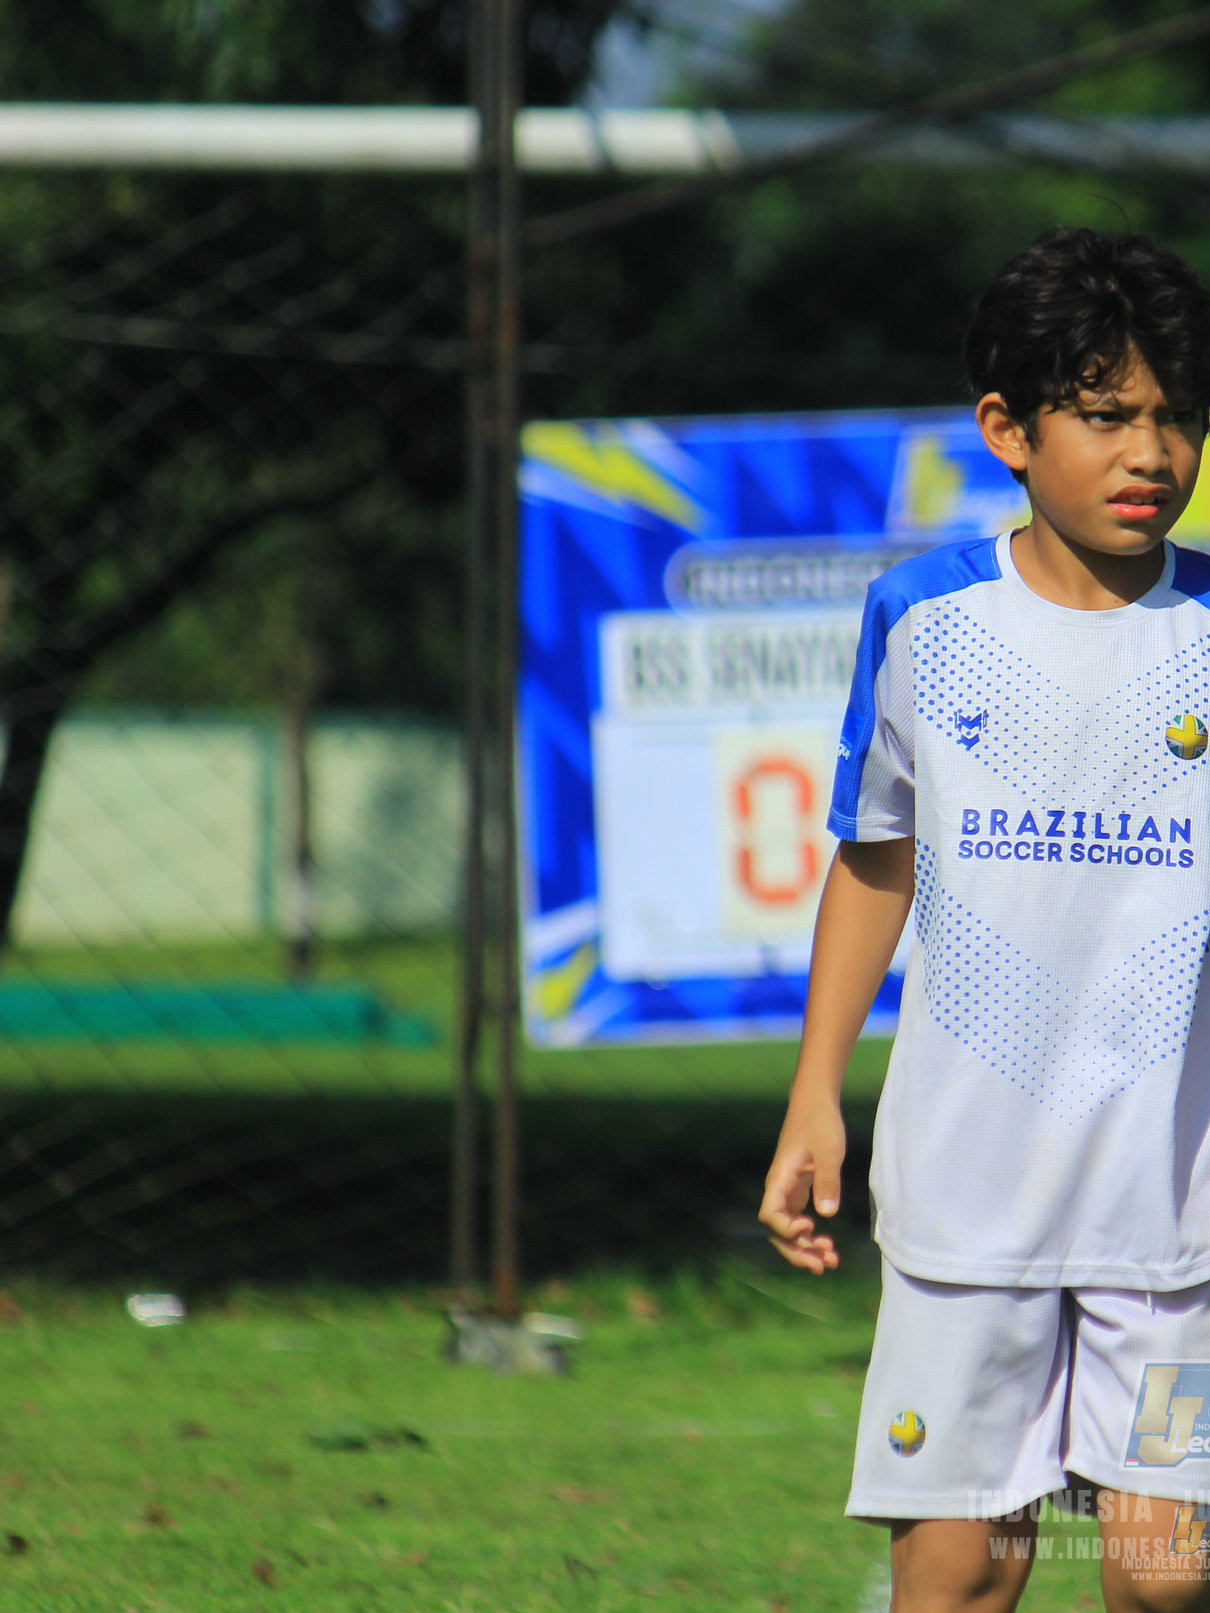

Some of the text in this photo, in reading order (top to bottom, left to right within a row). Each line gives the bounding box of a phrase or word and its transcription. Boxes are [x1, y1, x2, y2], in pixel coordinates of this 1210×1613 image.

[733, 753, 820, 905] 0
[961, 809, 1191, 844] BRAZILIAN
[957, 840, 1194, 869] SOCCER SCHOOLS
